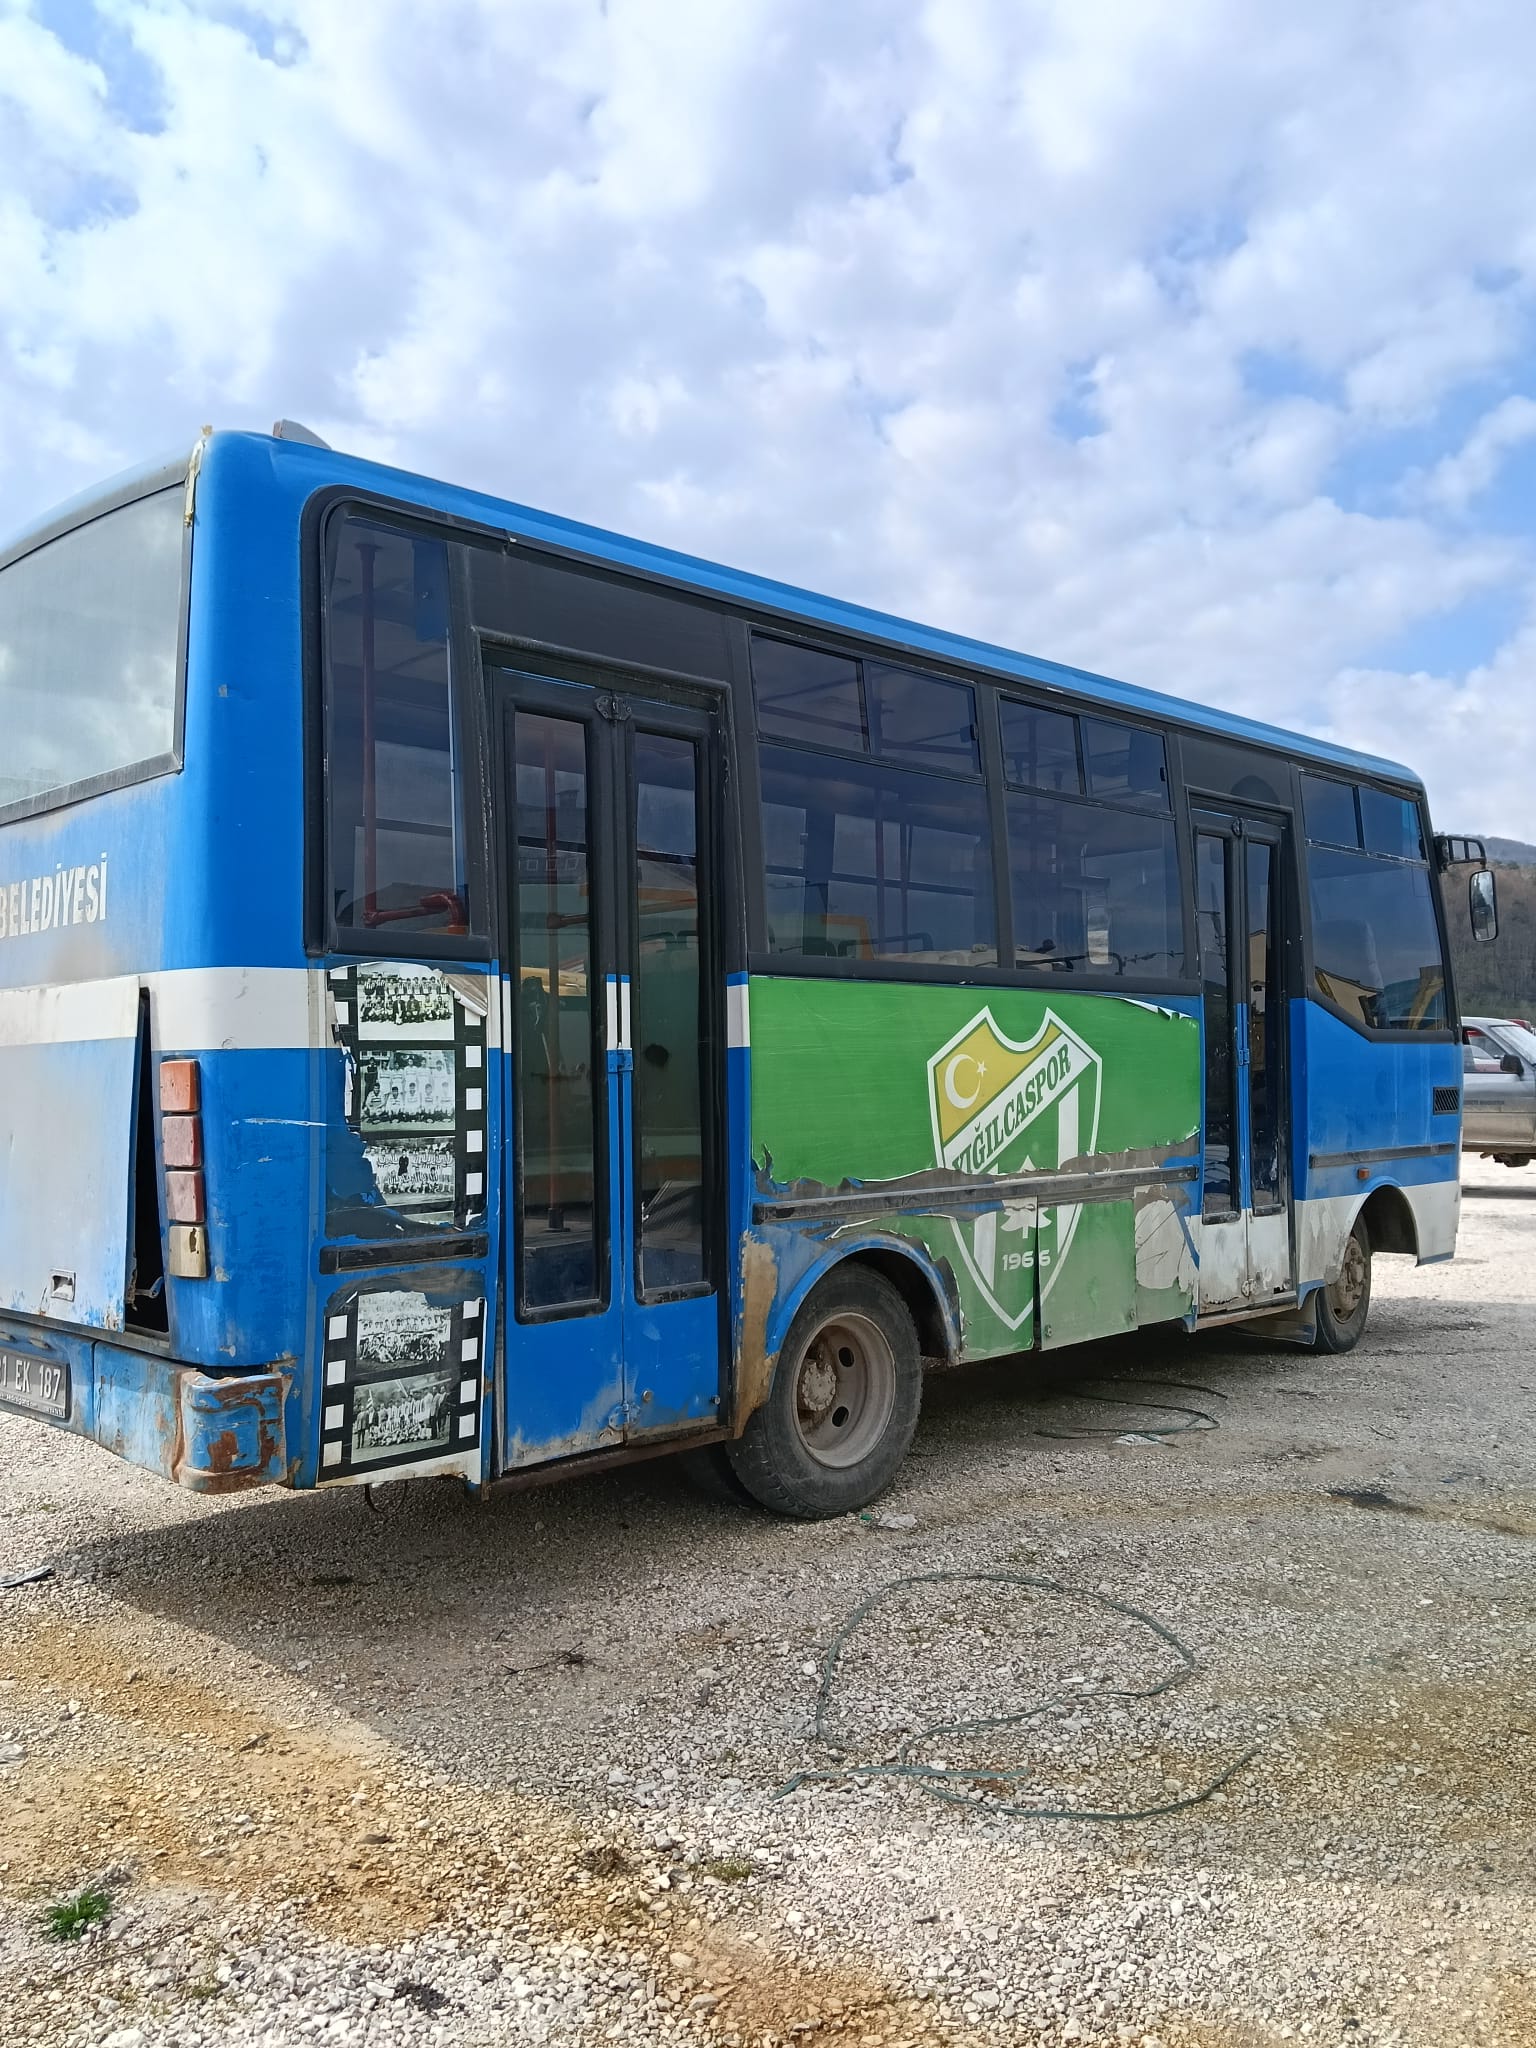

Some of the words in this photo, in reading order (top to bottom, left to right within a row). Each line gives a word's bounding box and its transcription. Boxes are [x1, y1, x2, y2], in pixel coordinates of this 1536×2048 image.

[0, 853, 107, 938] BELEDİYESİ
[1002, 1250, 1051, 1272] 1966
[16, 1359, 31, 1393] EK
[40, 1364, 61, 1401] 187
